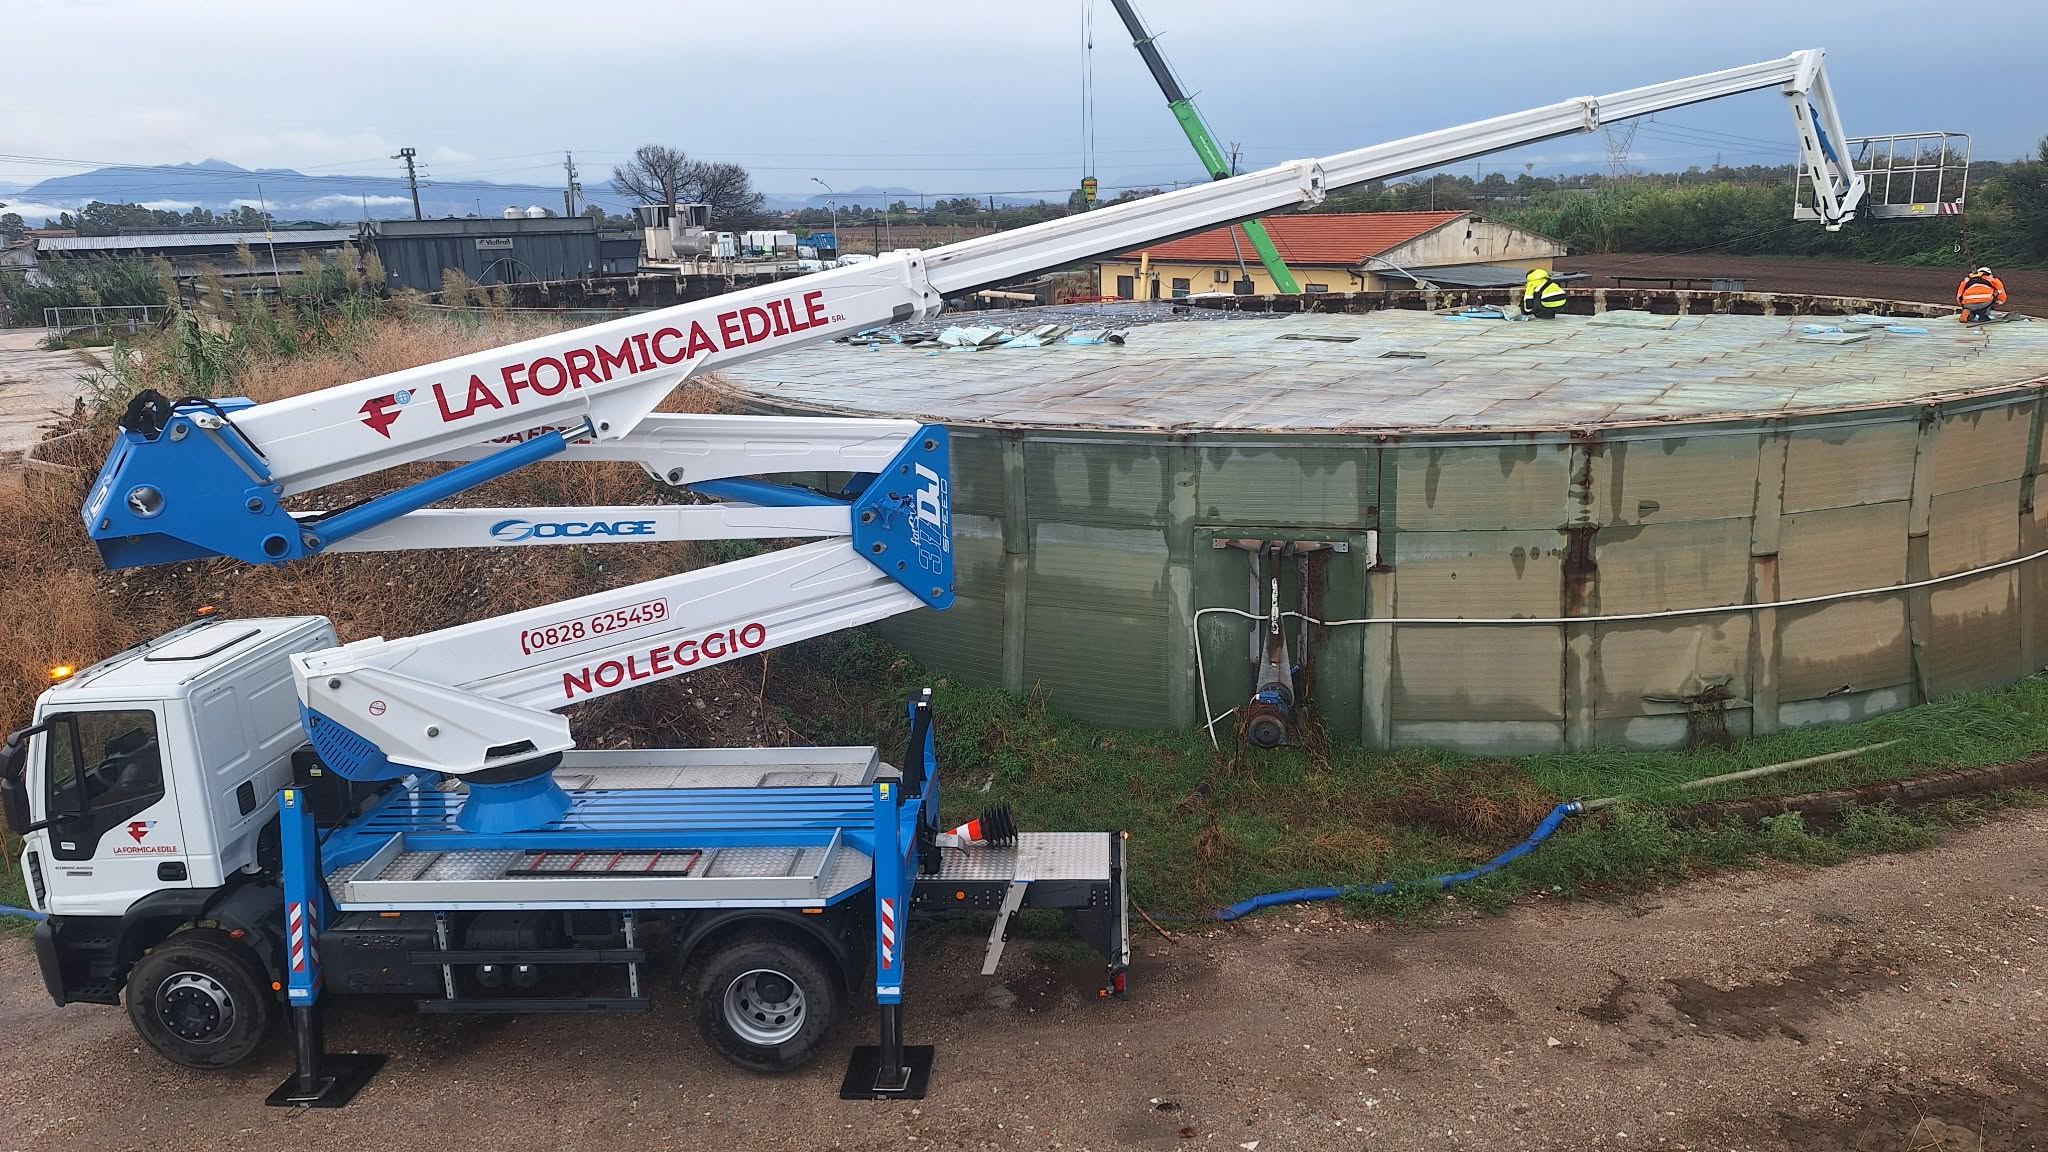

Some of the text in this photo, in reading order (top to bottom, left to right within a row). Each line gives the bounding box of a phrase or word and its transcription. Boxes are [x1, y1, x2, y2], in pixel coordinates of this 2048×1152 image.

[432, 290, 846, 423] LA FORMICA EDILE SRL
[489, 519, 656, 542] SOCAGE
[941, 478, 949, 554] SPEED
[530, 602, 666, 649] 0828 625459
[563, 623, 766, 699] NOLEGGIO
[157, 845, 177, 853] EDILE
